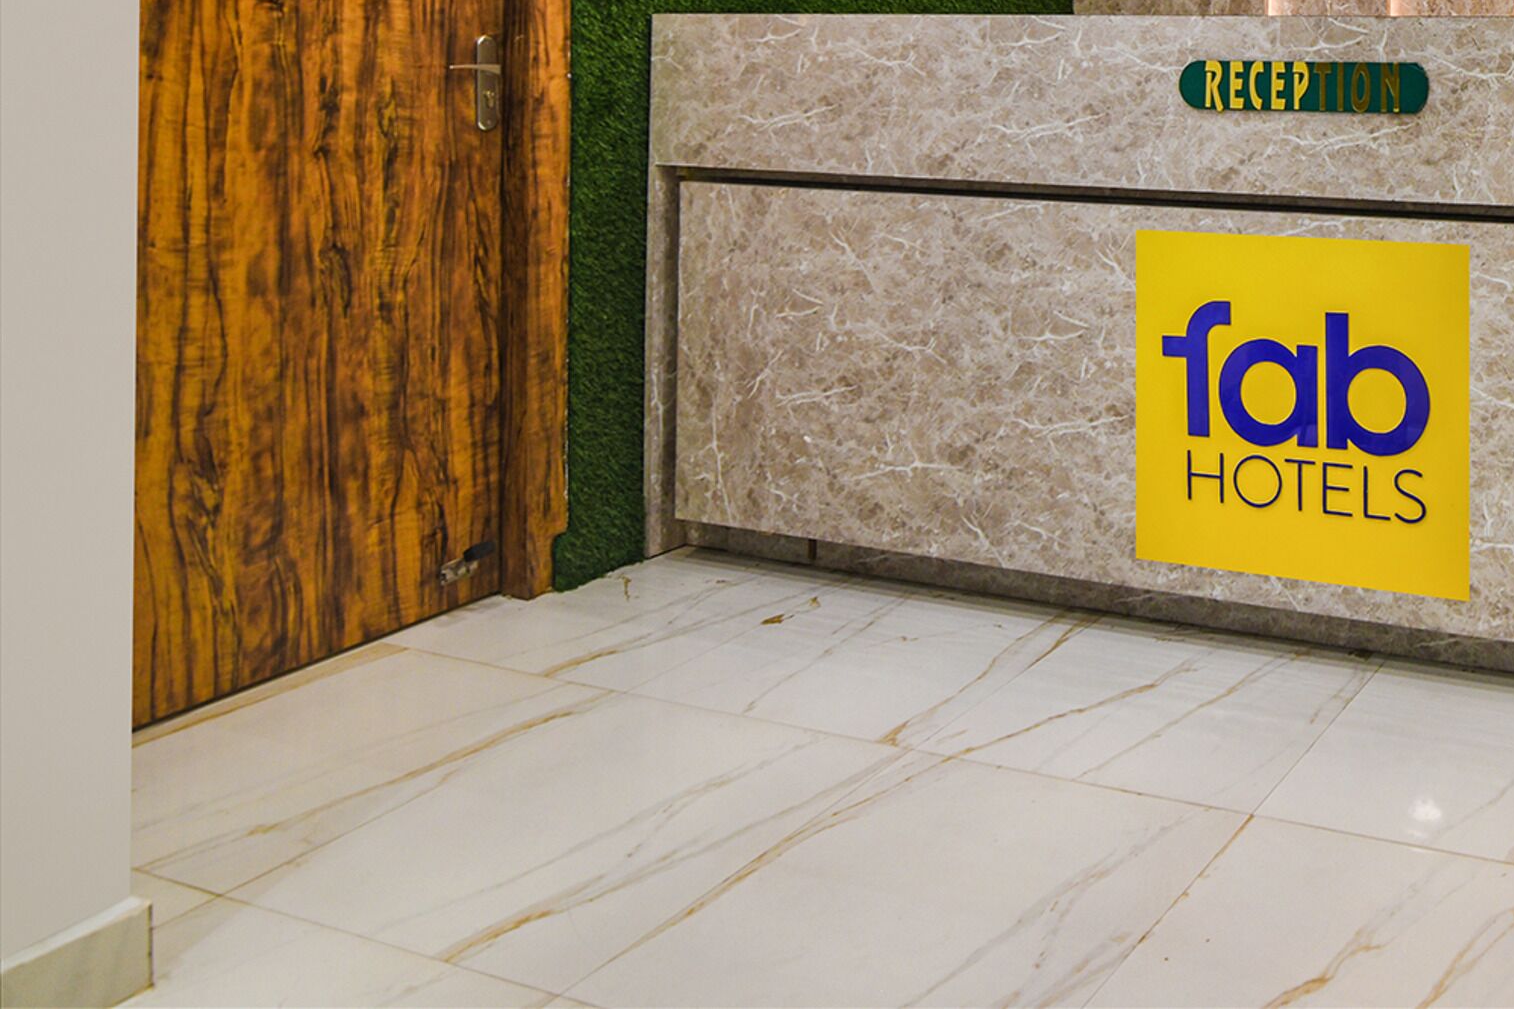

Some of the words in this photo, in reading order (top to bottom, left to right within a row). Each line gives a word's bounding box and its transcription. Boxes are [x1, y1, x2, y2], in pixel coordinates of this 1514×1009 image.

[1204, 60, 1400, 113] RECEPTION
[1162, 300, 1431, 457] fab
[1186, 449, 1427, 524] HOTELS
